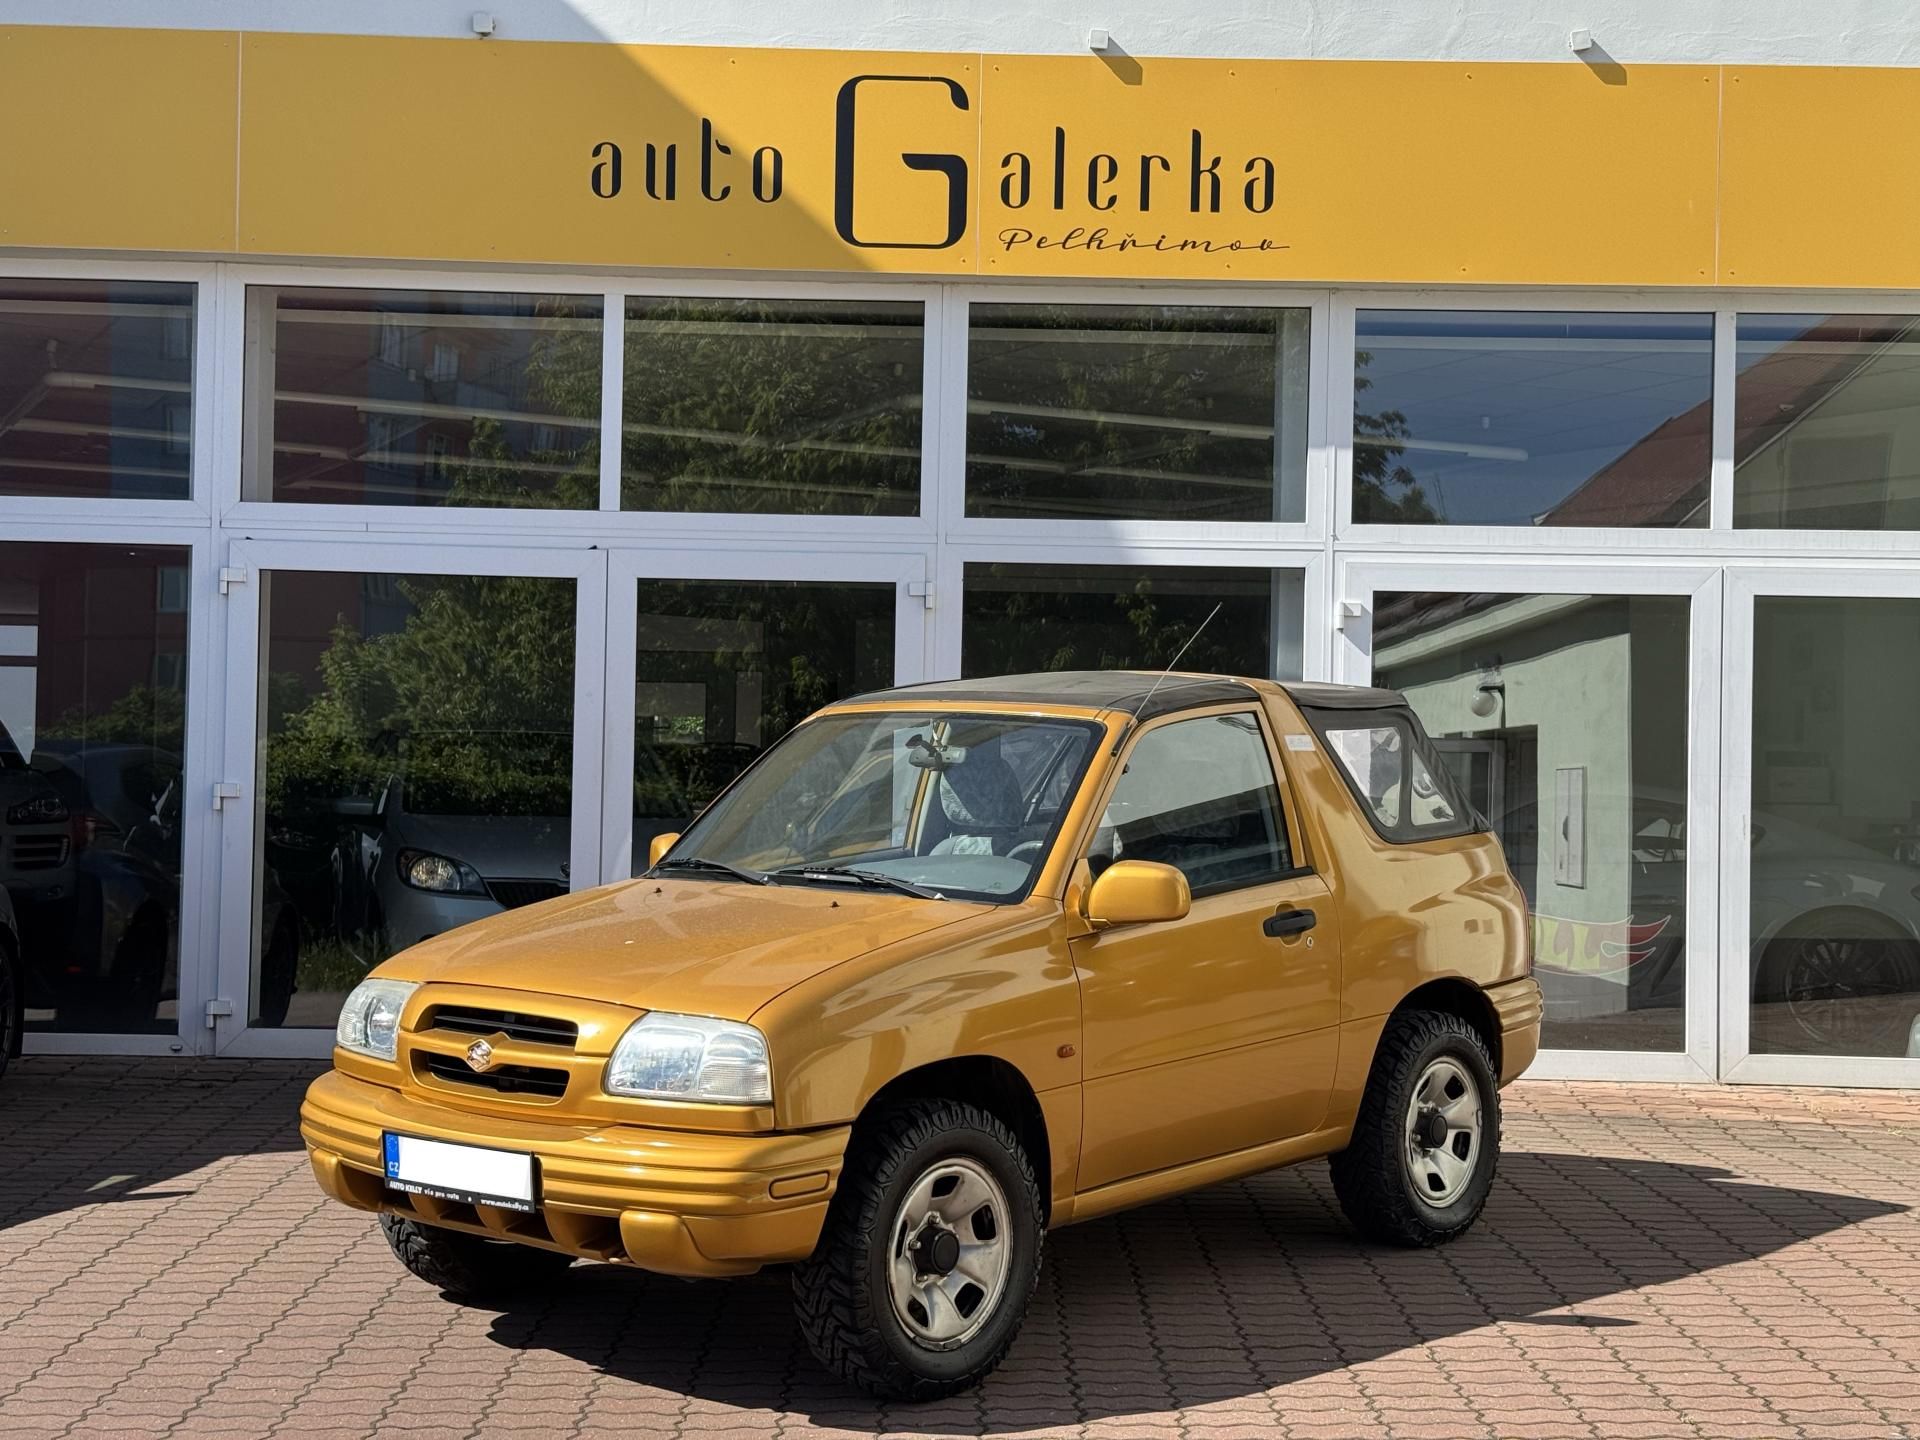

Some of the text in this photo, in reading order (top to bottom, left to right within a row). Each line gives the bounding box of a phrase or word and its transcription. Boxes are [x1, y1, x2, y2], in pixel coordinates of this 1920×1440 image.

[591, 75, 1275, 249] auto Galerka
[998, 227, 1290, 253] Pelhřimov
[388, 1161, 399, 1172] CZ
[389, 1180, 405, 1191] AUTO
[405, 1184, 423, 1194] KELLY
